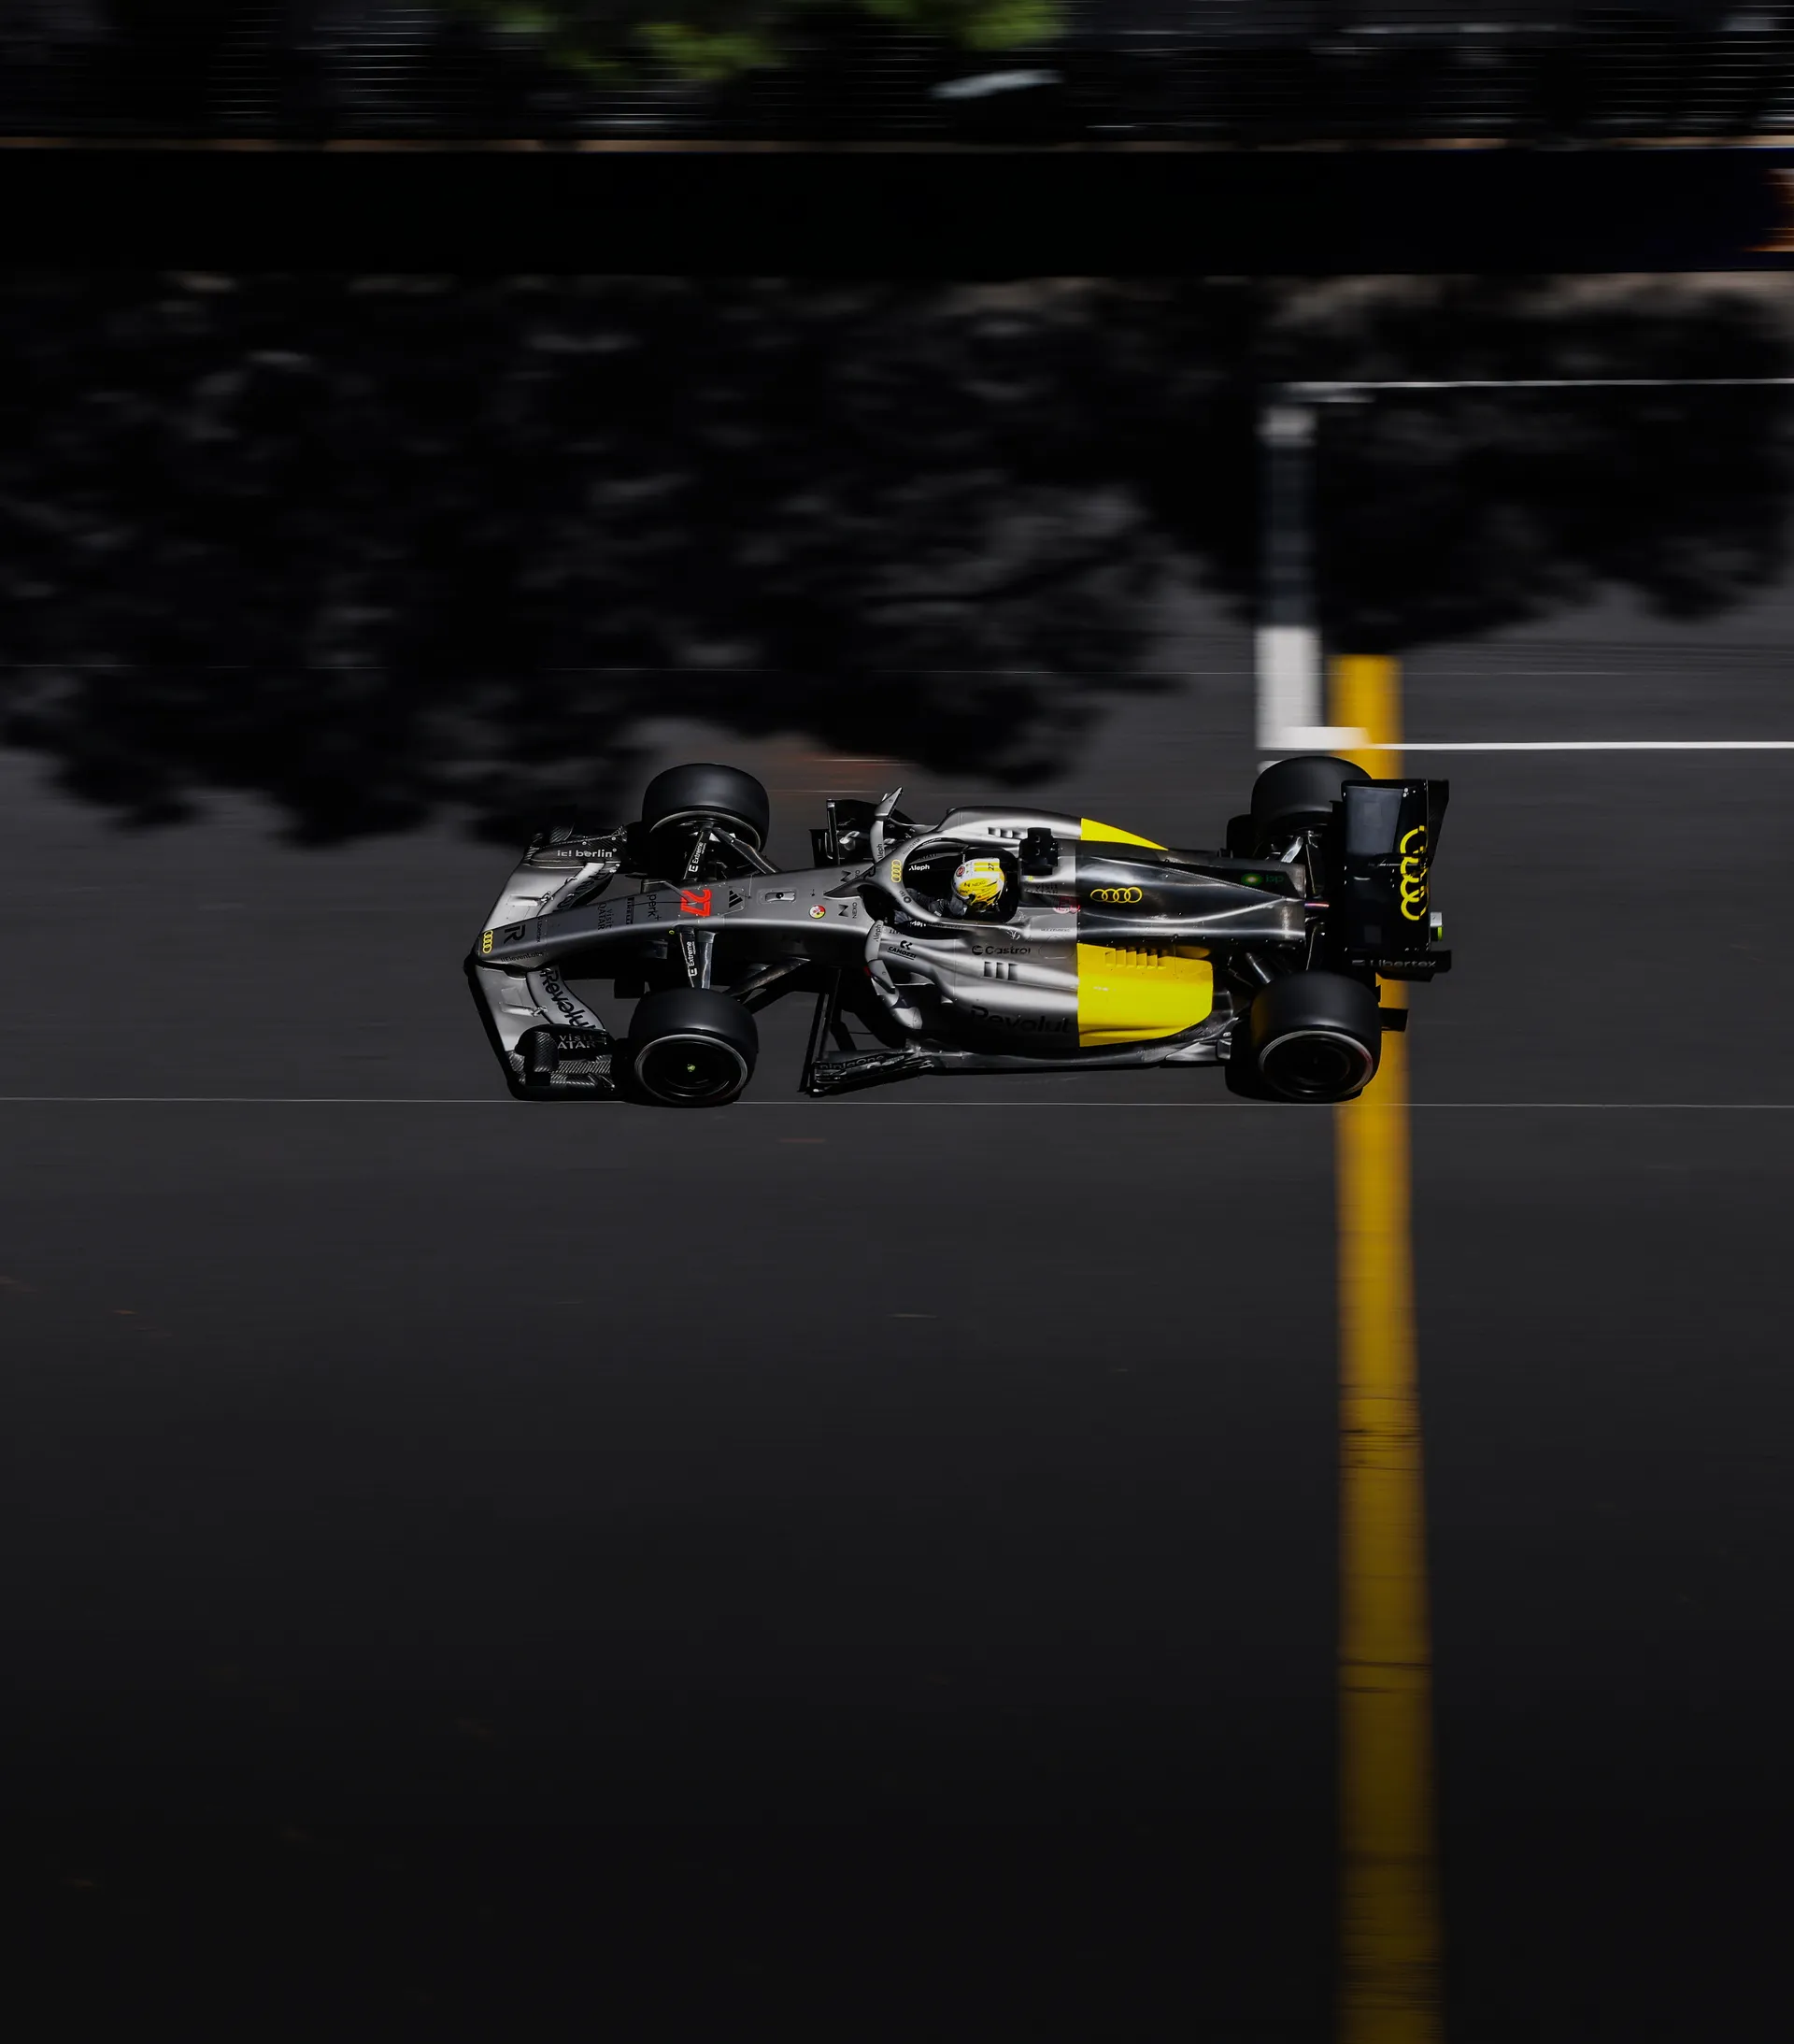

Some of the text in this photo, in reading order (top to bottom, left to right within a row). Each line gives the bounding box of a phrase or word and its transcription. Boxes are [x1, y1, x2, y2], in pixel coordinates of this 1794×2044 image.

[576, 849, 613, 858] berlin
[679, 888, 712, 918] 27
[985, 945, 1031, 955] Castrol
[539, 969, 596, 1028] Revolu
[971, 1005, 1073, 1033] Revolut
[557, 1039, 597, 1050] ATAR
